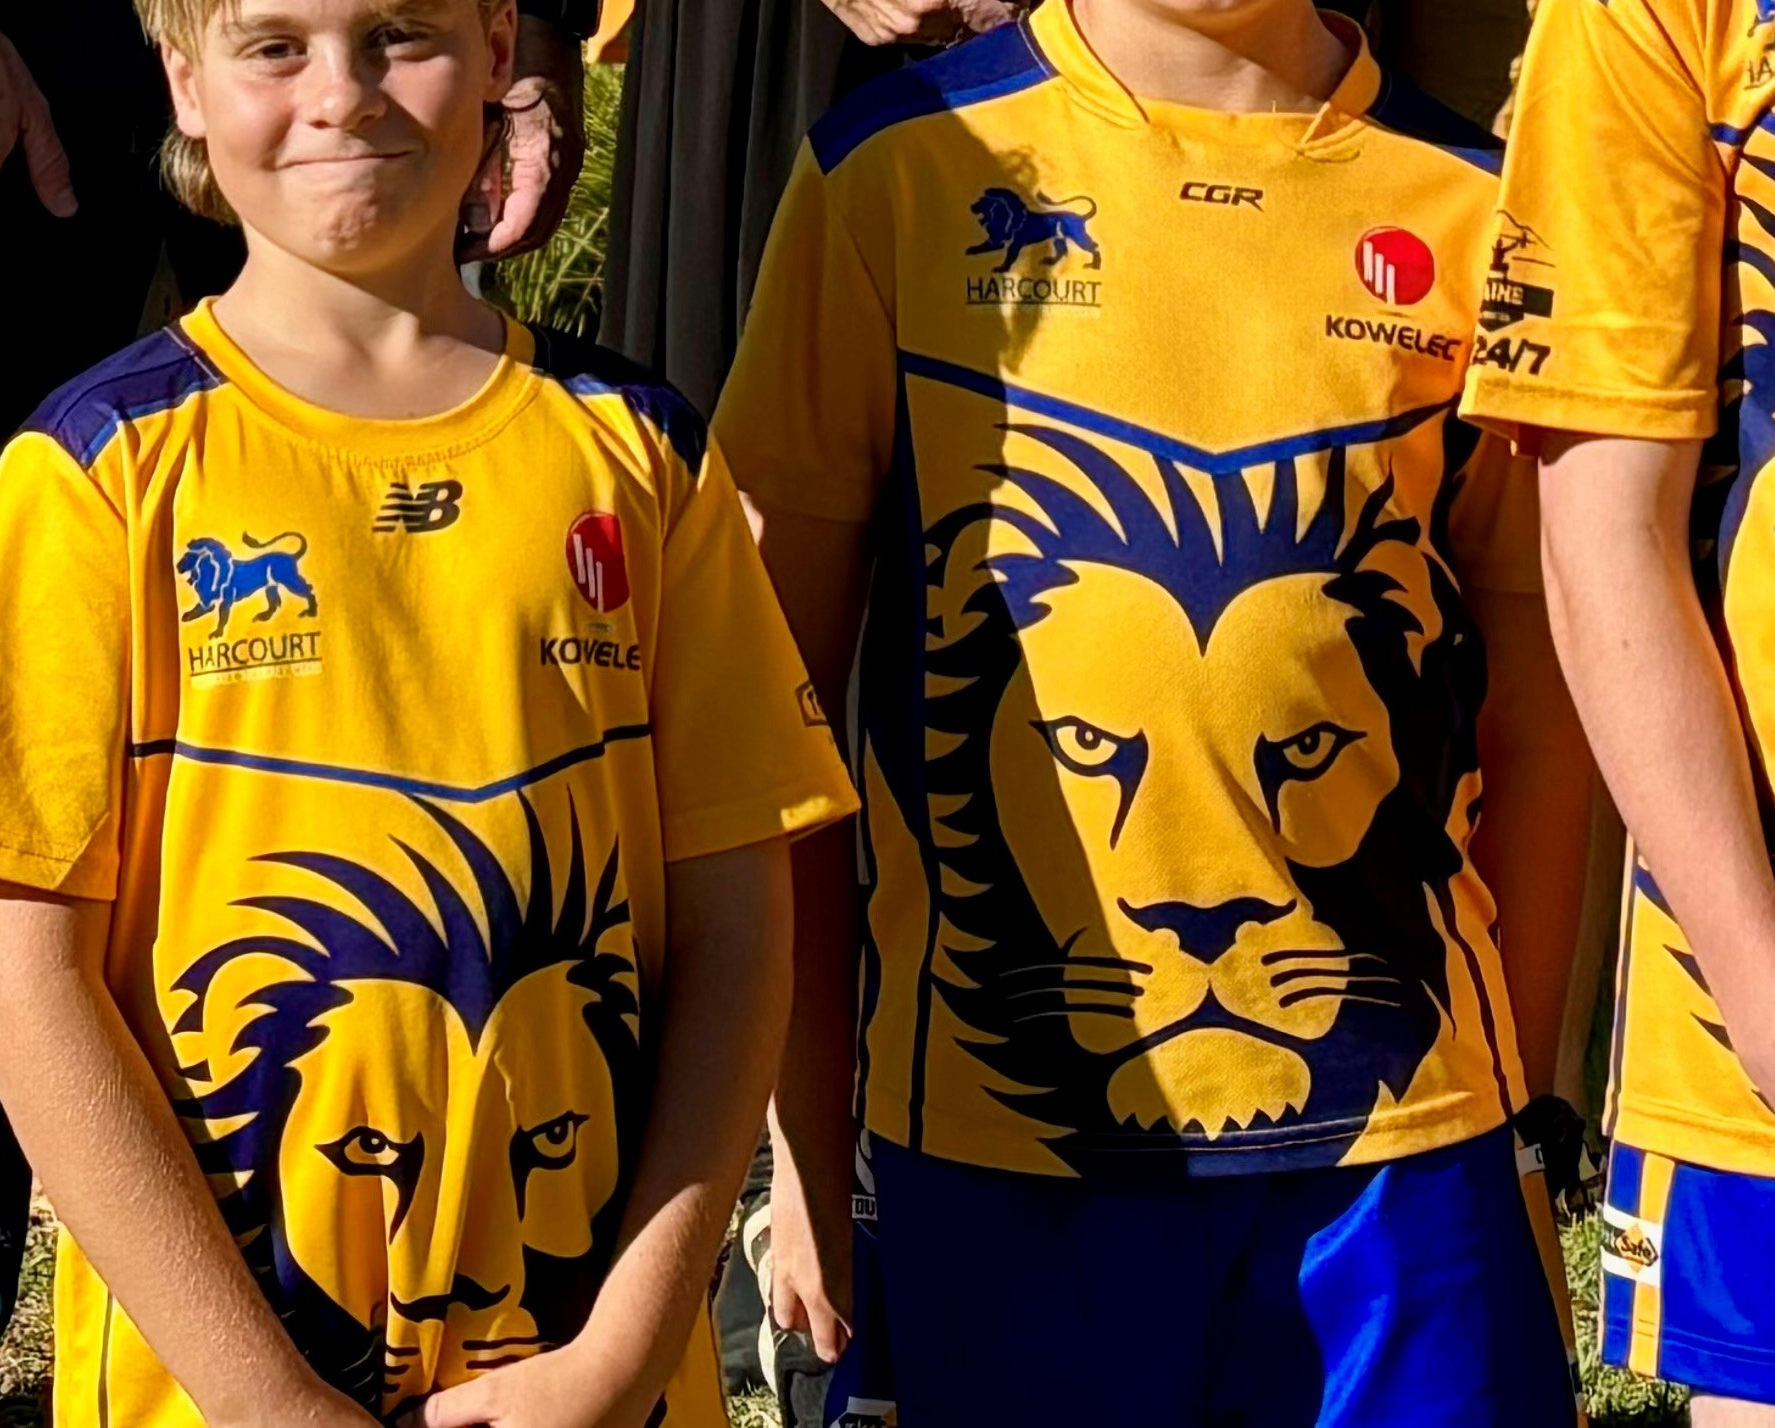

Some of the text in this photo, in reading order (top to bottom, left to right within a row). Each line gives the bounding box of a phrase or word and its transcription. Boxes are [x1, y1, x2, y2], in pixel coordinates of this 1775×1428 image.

[1179, 181, 1264, 213] CGR
[966, 277, 1102, 304] HARCOURT
[1325, 314, 1463, 362] KOWELEC
[188, 631, 322, 673] HARCOURT
